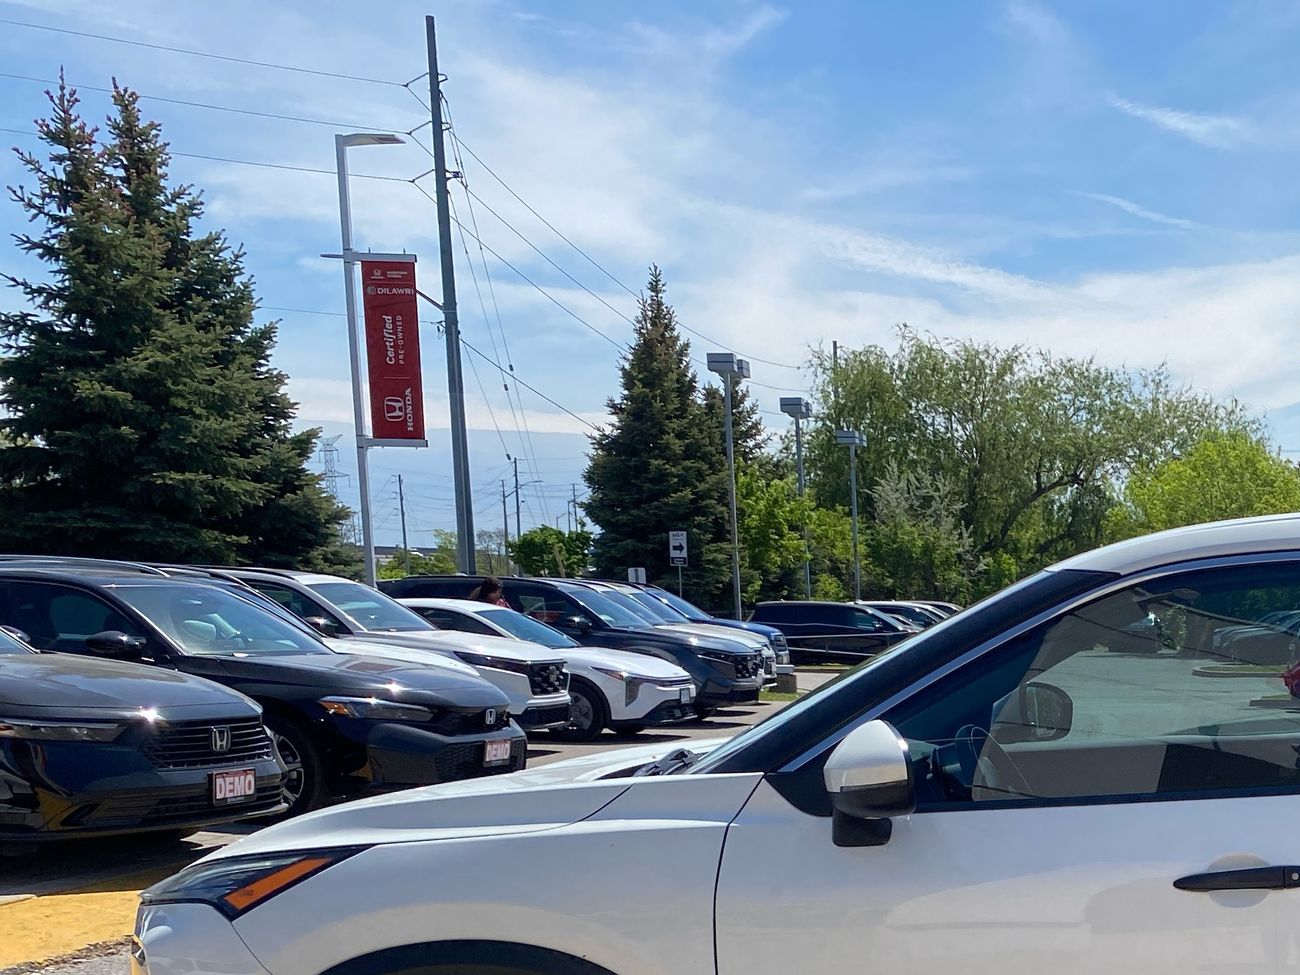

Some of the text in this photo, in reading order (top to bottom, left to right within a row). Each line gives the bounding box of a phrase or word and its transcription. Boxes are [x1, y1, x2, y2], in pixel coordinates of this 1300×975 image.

[382, 315, 396, 364] Certified
[396, 315, 405, 364] PRE-OWNED
[404, 387, 414, 431] HONDA
[486, 743, 510, 761] DEMO
[216, 775, 255, 799] DEMO
